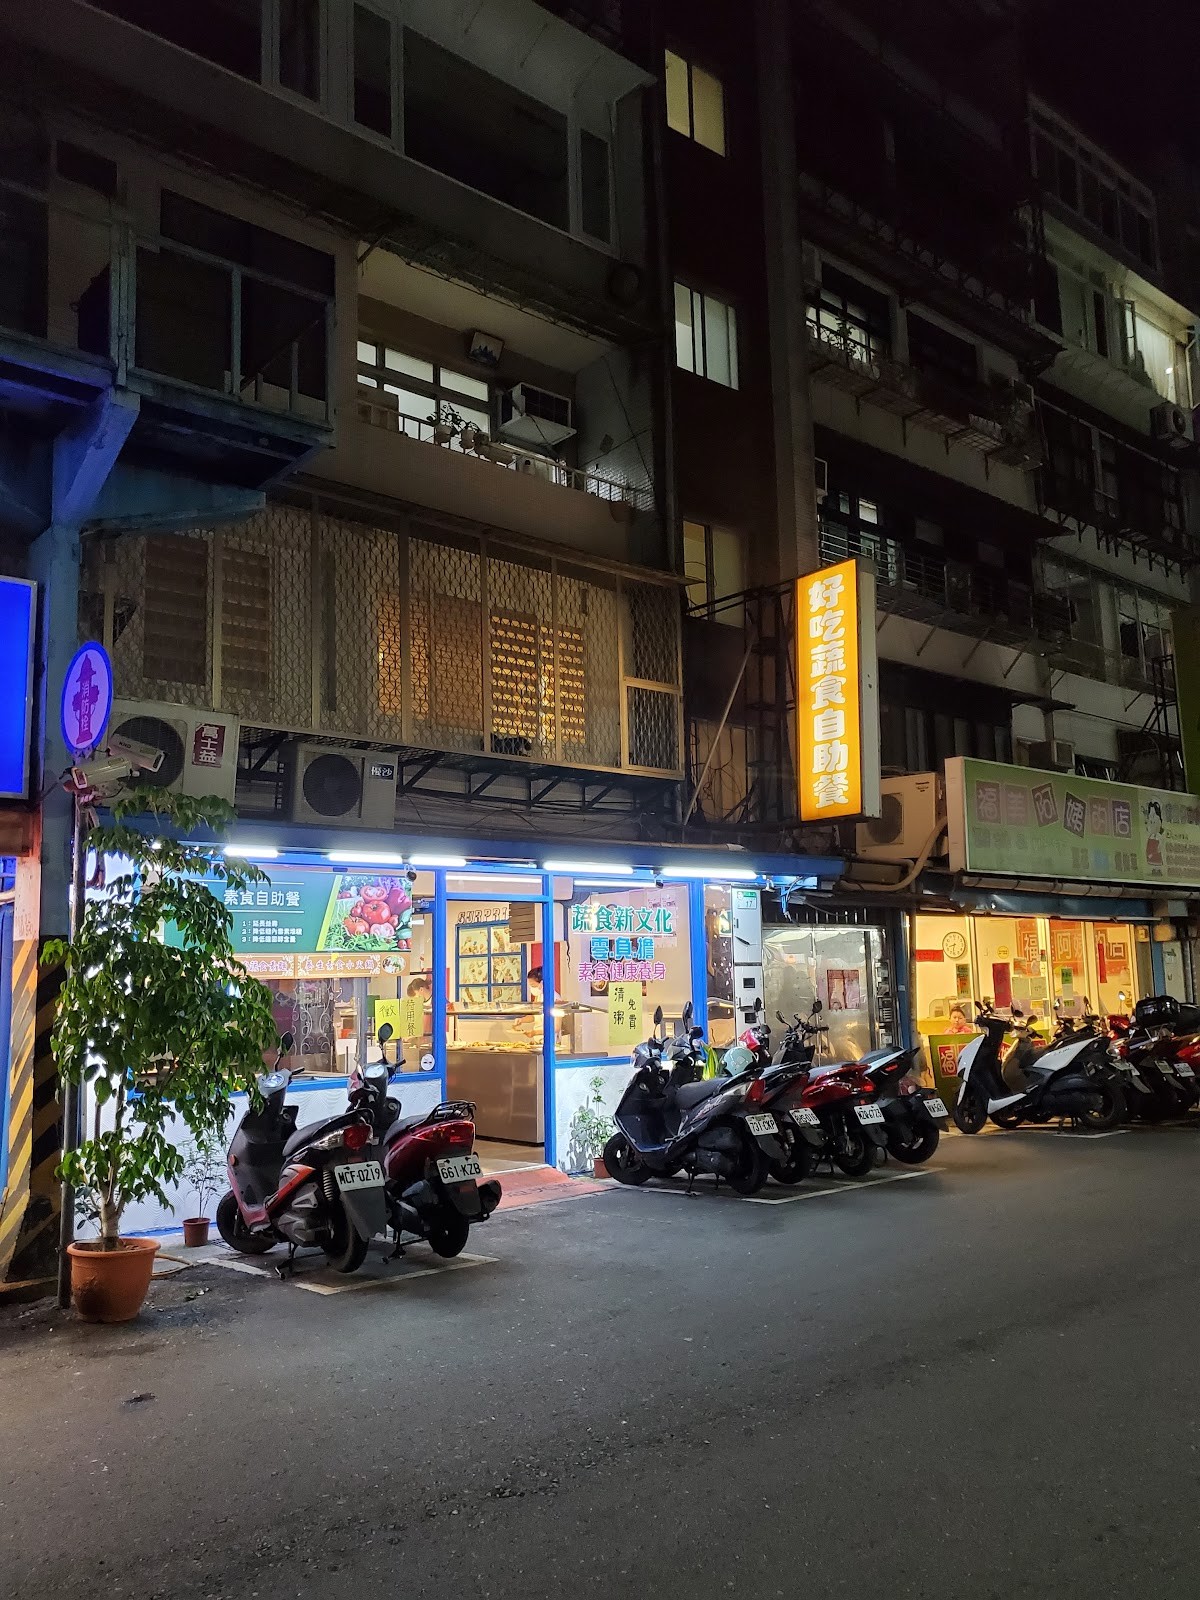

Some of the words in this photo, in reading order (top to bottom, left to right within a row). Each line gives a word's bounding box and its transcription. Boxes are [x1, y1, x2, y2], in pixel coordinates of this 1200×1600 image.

[807, 573, 849, 809] 好吃蔬食自助餐
[223, 889, 300, 908] 素食自助餐
[571, 903, 673, 933] 蔬食新文化
[578, 962, 666, 982] 素食健康養身
[338, 1167, 382, 1186] MCF-0219
[440, 1162, 481, 1180] 661-KZB
